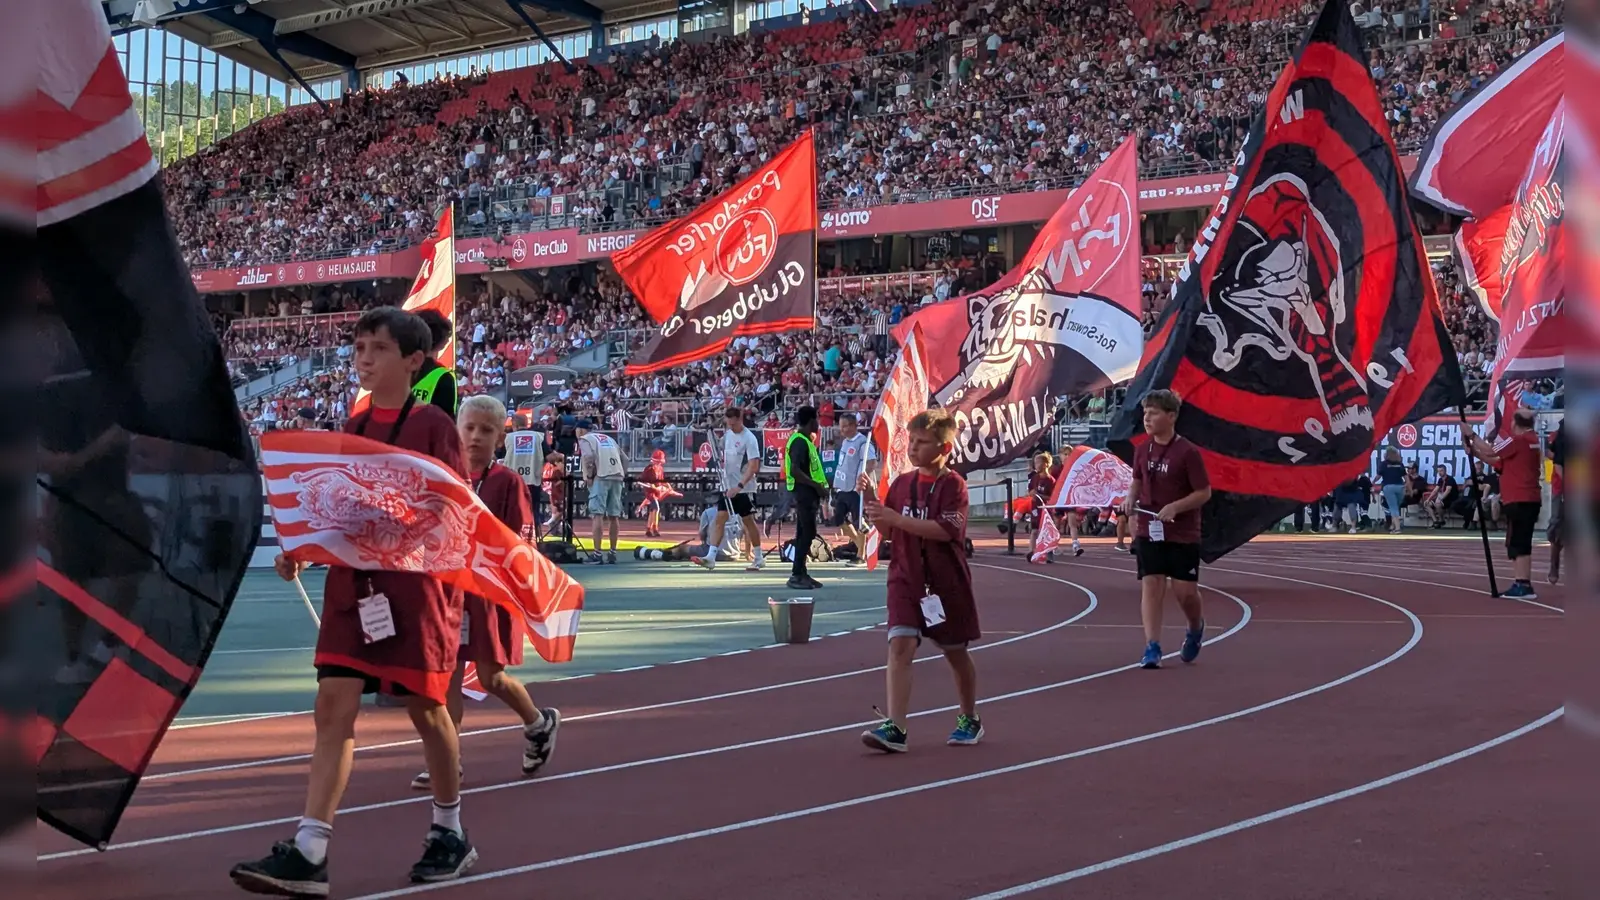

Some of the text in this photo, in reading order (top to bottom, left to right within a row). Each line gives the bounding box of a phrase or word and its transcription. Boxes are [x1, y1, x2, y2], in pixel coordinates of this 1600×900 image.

[835, 210, 870, 227] LOTTO
[328, 260, 377, 277] HELMSAUER
[1399, 433, 1416, 441] FCN
[518, 466, 531, 476] 08
[471, 541, 557, 593] FCN
